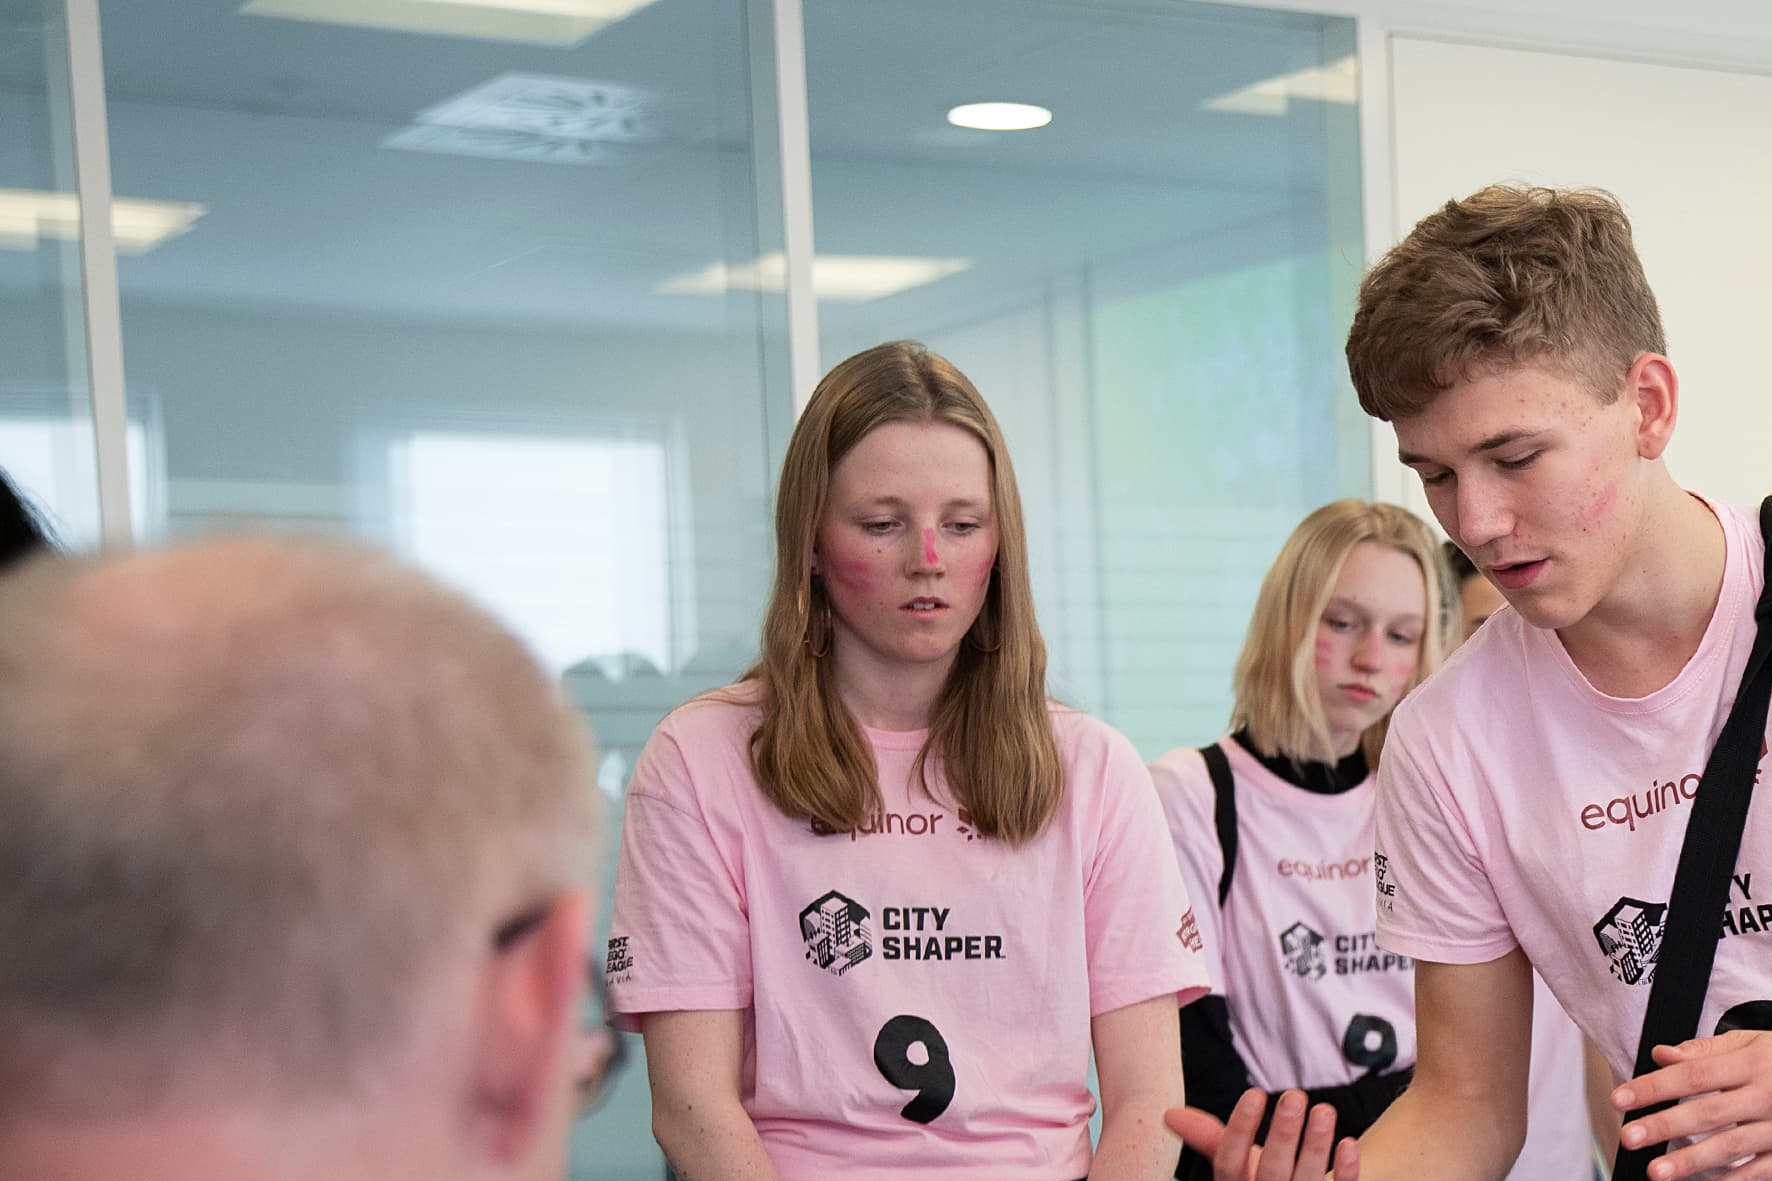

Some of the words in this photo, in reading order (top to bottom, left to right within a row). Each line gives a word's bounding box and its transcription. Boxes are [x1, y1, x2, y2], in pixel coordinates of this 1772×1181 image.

[1580, 773, 1703, 832] equino
[1277, 856, 1372, 884] equinor
[883, 907, 951, 931] CITY
[882, 935, 1003, 960] SHAPER
[1335, 954, 1416, 975] SHAPE
[873, 1014, 956, 1125] 9
